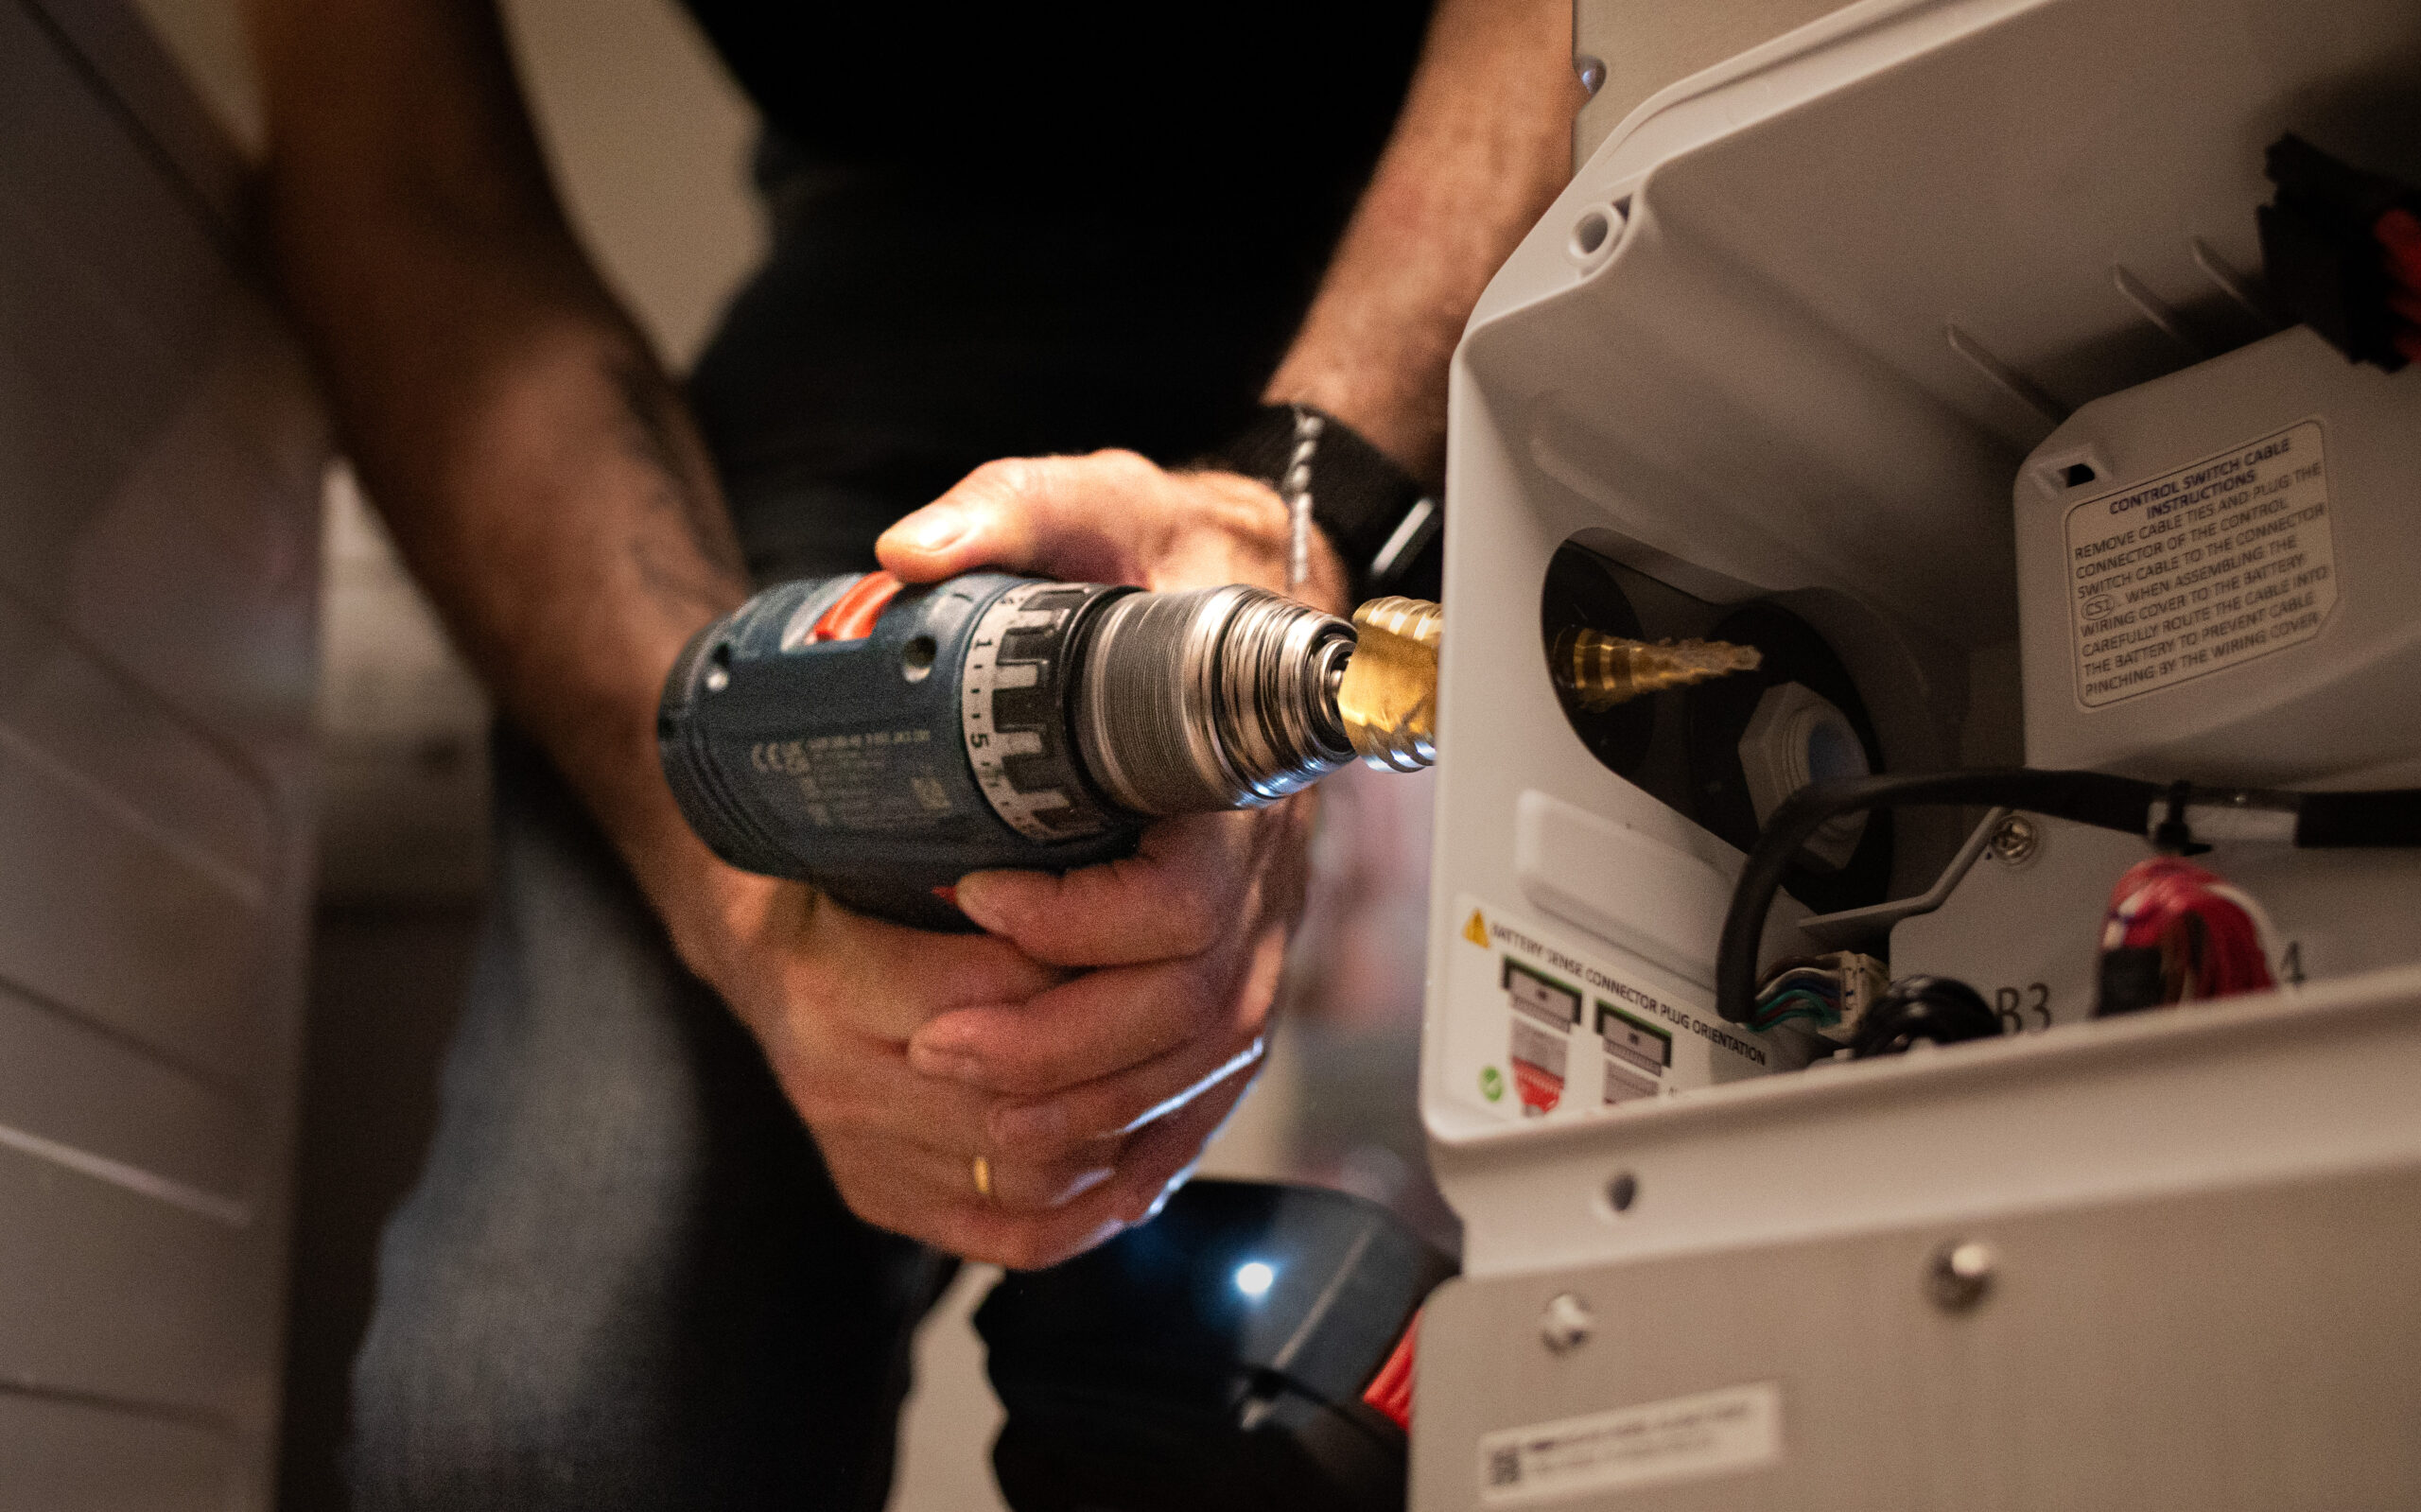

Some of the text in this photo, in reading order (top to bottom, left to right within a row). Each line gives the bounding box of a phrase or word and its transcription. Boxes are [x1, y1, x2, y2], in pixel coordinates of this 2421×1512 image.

[2075, 463, 2321, 560] REMOVE CABLE TIES AND PLUG THE
[2110, 439, 2290, 515] CONTROL SWITCH CABLE
[2148, 470, 2256, 519] INSTRUCTIONS
[2077, 497, 2288, 579] CONNECTOR OF THE CONTROL
[2078, 503, 2325, 599] SWITCH CABLE TO THE CONNECTOR
[2125, 581, 2169, 603] WHEN
[2174, 547, 2264, 588] ASSEMBLING
[2270, 535, 2297, 556] THE
[2081, 553, 2305, 637] WIRING COVER TO THE BATTERY
[2081, 567, 2327, 657] CAREFULLY ROUTE THE CABLE INTO
[2083, 592, 2314, 677] THE BATTERY TO PREVENT CABLE
[974, 638, 993, 650] 1
[2084, 614, 2319, 697] PINCHING BY THE WIRING COVER
[970, 733, 989, 748] 5
[1492, 924, 1766, 1066] BATTERY SENSE CONNECTOR PLUG ORIENTATION
[1995, 982, 2051, 1034] B3
